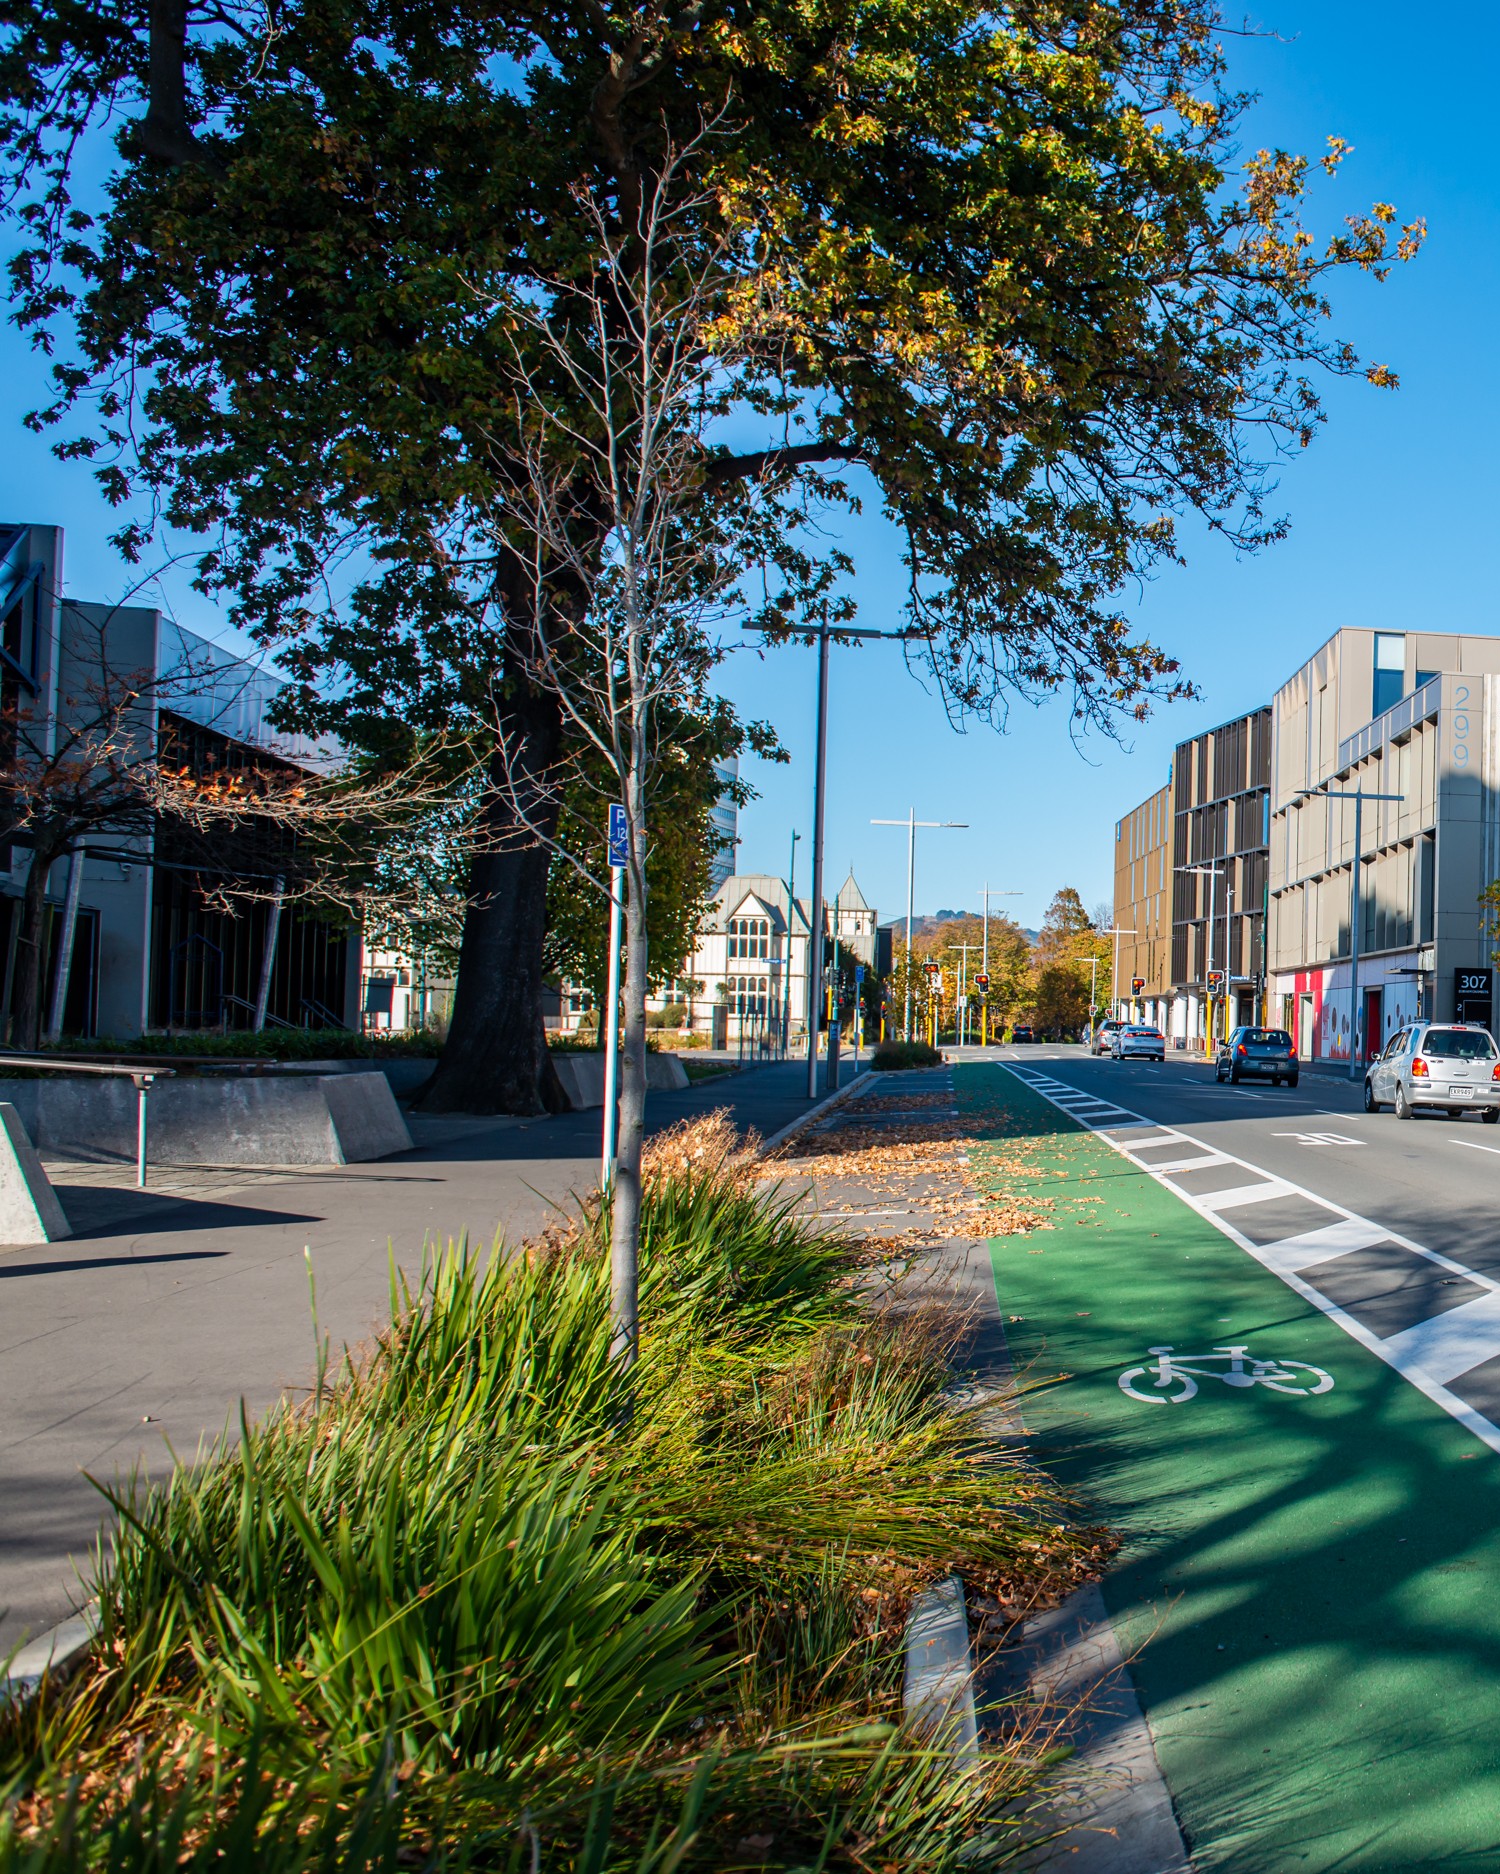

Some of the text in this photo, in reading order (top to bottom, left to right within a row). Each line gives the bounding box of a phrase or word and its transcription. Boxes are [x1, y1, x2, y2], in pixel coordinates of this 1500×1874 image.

[1453, 686, 1471, 769] 299
[617, 827, 627, 839] 12
[1461, 975, 1487, 989] 307
[1457, 1003, 1462, 1011] 2
[1270, 1133, 1368, 1146] 30
